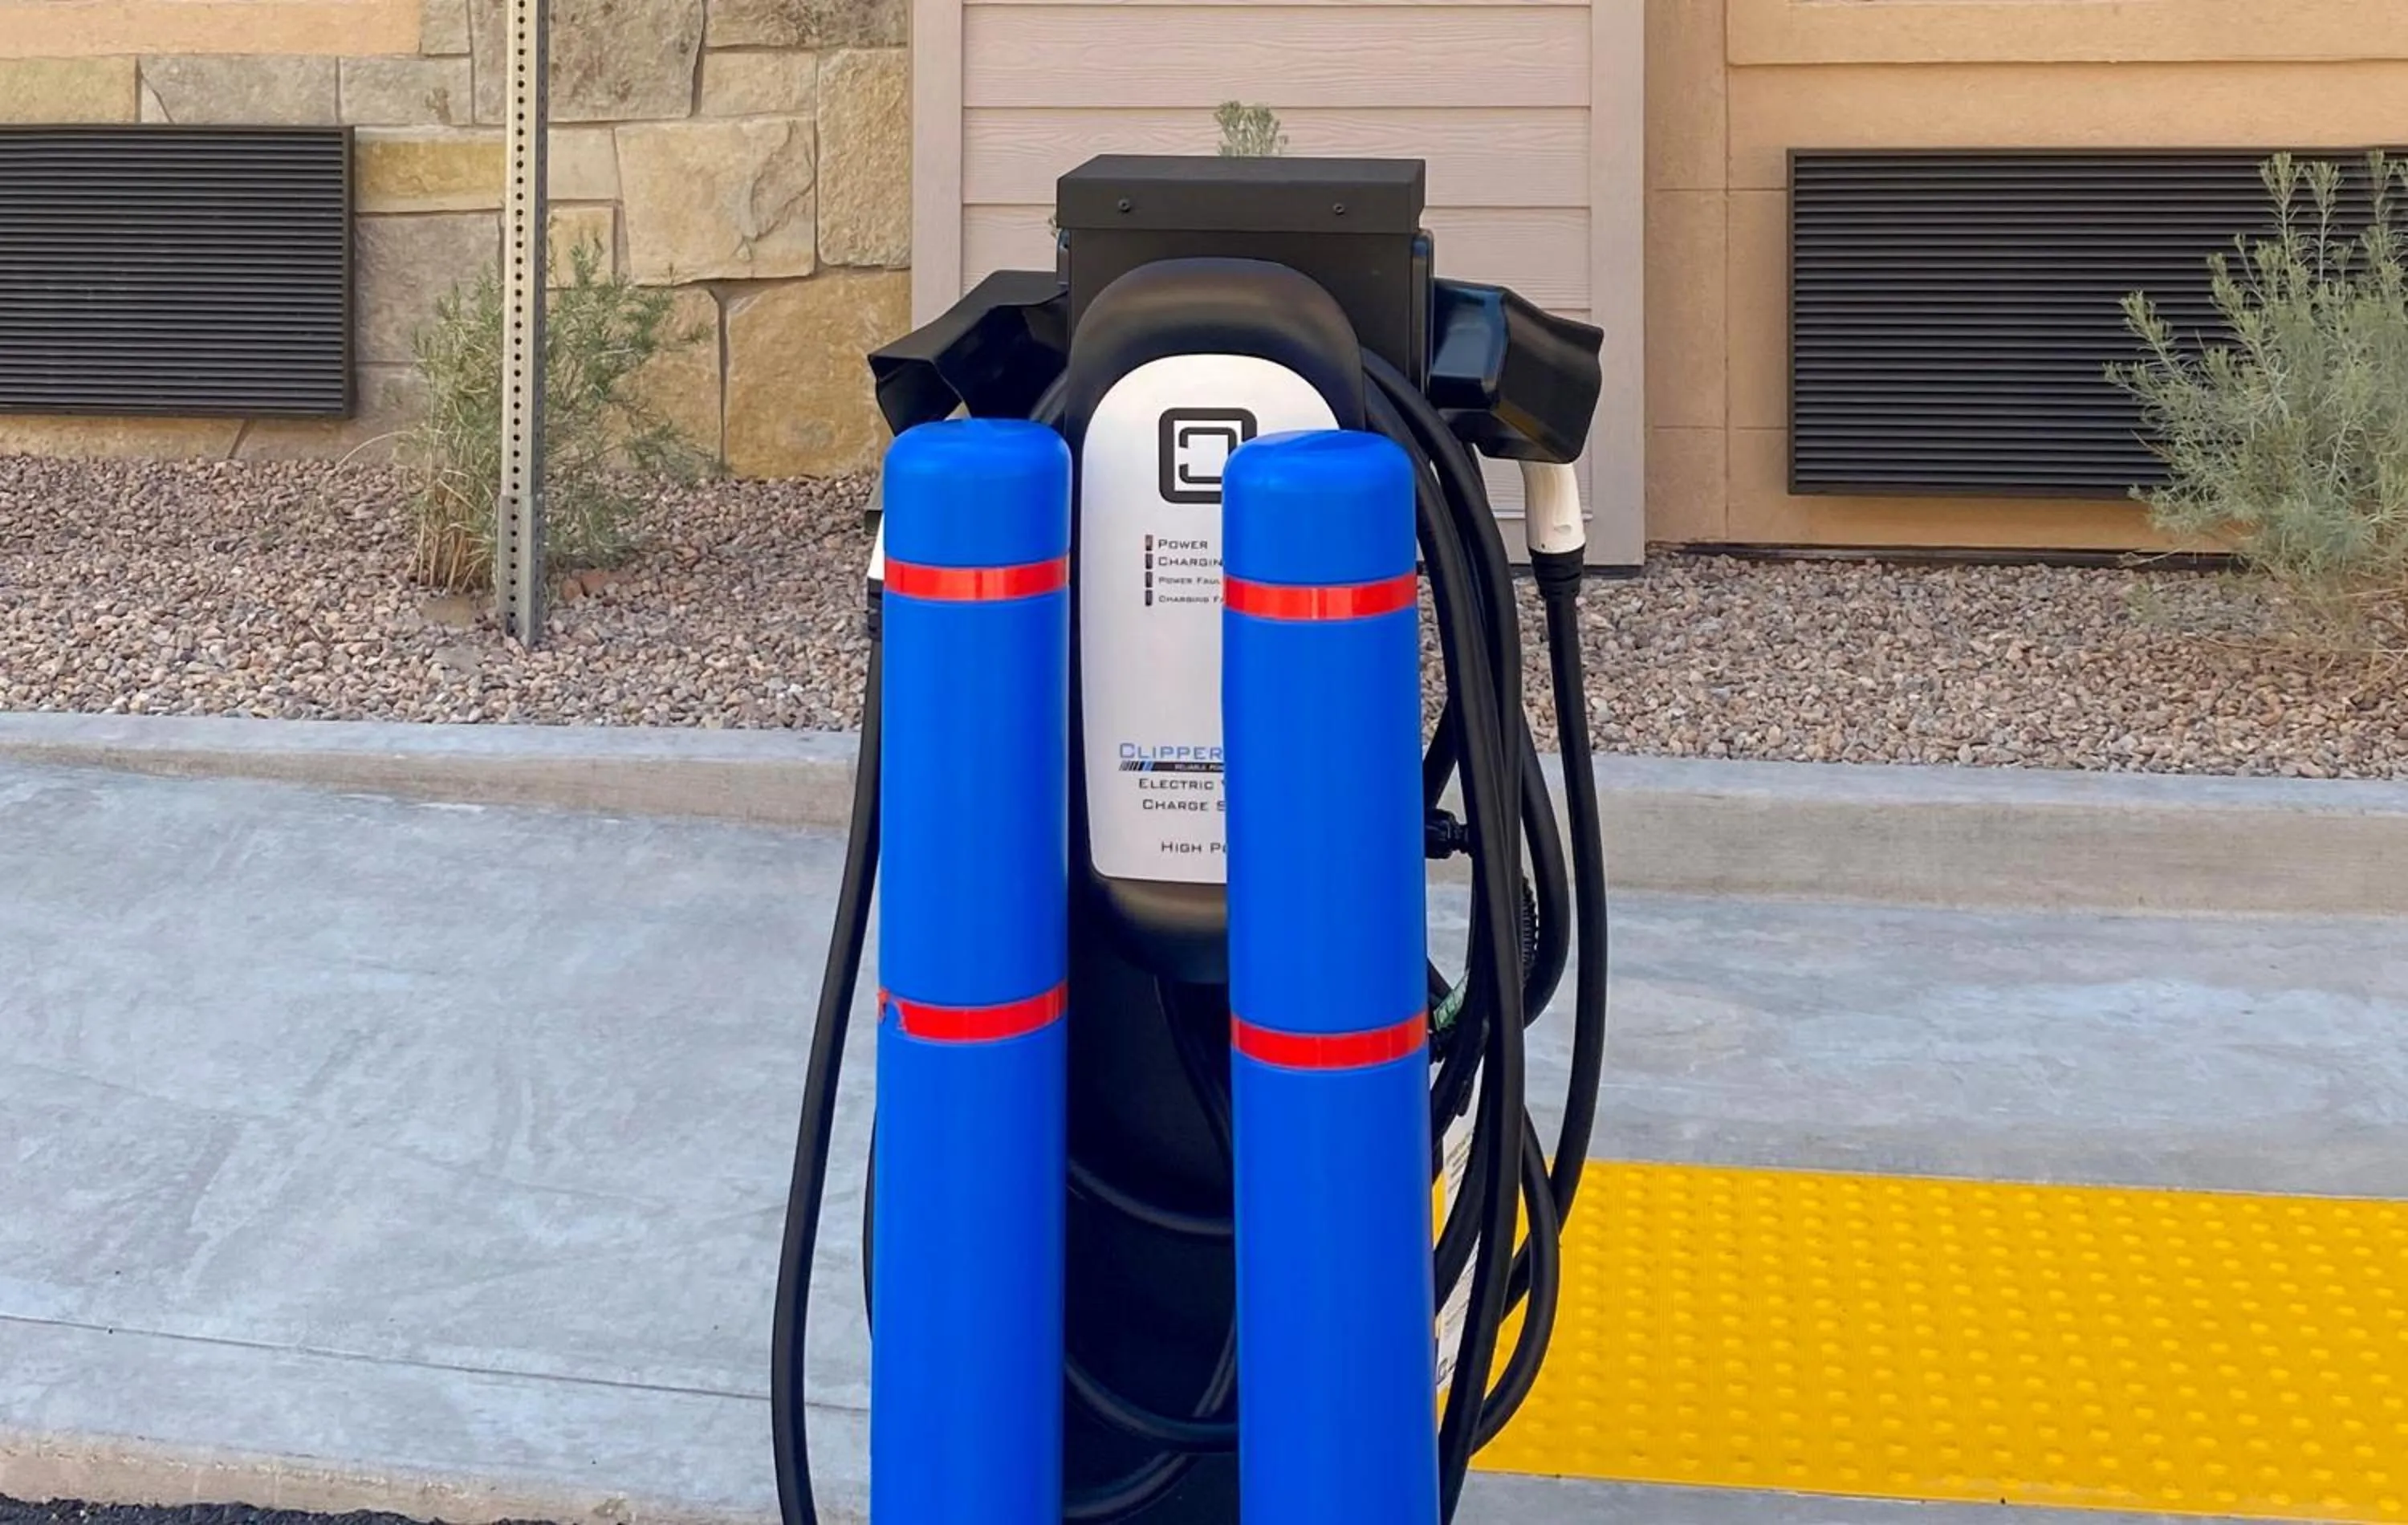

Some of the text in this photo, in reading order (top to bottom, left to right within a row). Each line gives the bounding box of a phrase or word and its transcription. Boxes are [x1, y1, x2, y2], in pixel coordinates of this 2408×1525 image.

[1158, 539, 1208, 550] POWER
[1138, 778, 1214, 791] ELECTRIC
[1142, 799, 1208, 811] CHARGE
[1161, 841, 1202, 854] HIGH
